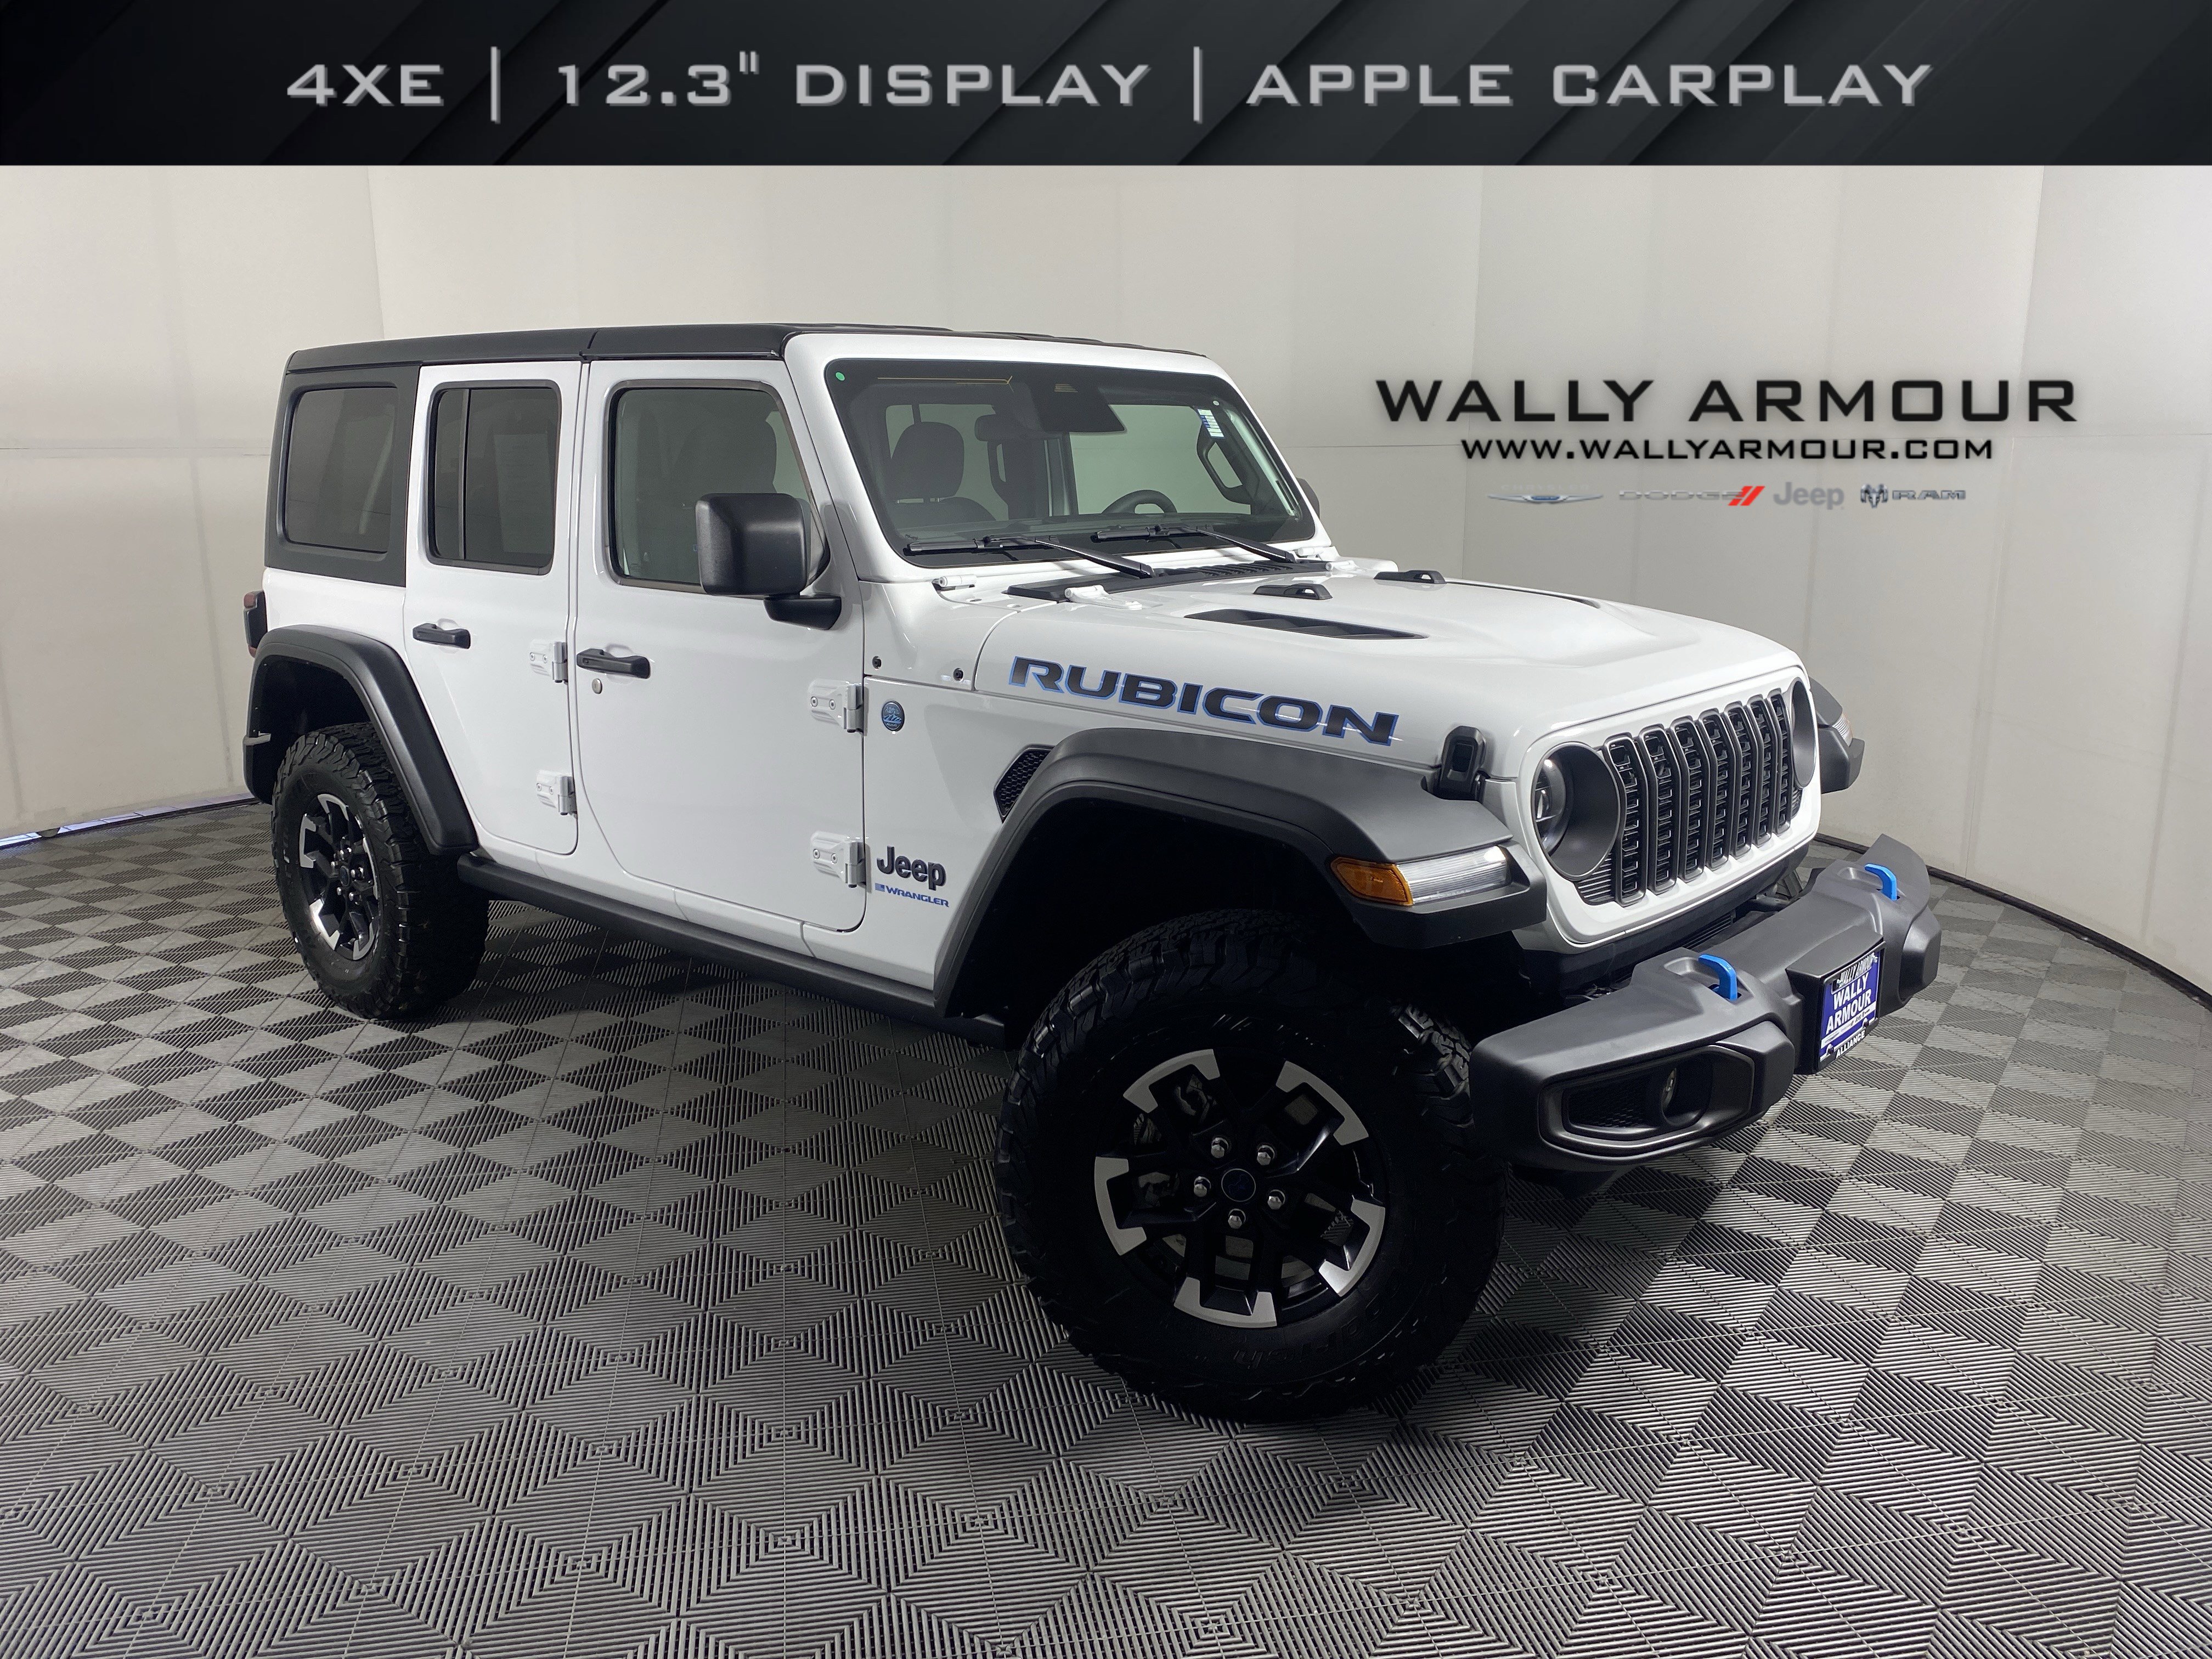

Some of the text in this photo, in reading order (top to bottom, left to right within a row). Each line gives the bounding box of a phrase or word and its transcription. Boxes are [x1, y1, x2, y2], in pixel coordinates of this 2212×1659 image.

[1008, 656, 1399, 747] RUBICON
[876, 845, 947, 891] Jeep
[885, 885, 950, 907] WRANGLER
[1825, 989, 1871, 1035] ARMOUR
[1833, 972, 1869, 1011] WALLY
[1836, 1030, 1866, 1059] ALLIANCE
